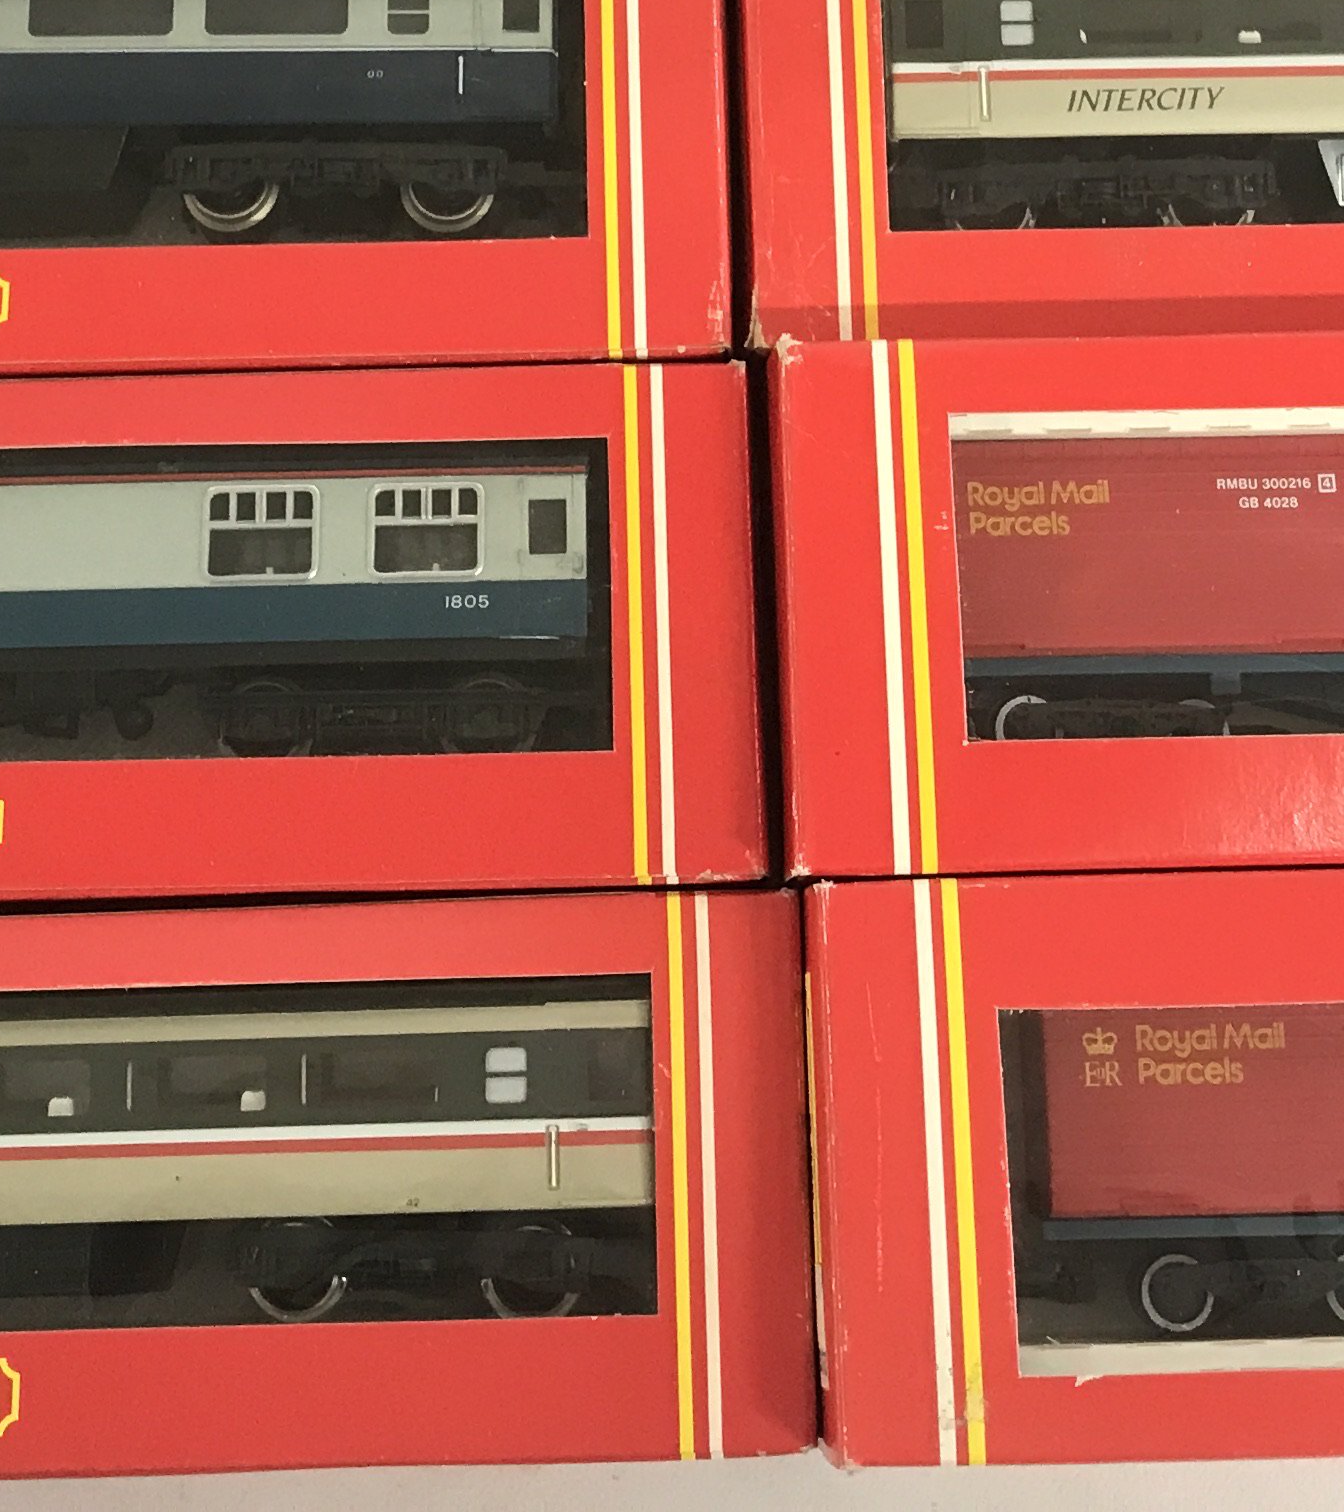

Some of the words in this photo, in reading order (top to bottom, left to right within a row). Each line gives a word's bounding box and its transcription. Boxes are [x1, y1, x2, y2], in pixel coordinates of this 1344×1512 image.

[1067, 86, 1225, 112] INTERCITY
[967, 481, 1045, 512] Royal
[1050, 479, 1110, 505] Mail
[1216, 478, 1258, 490] RMBU
[1262, 477, 1312, 490] 300216
[1238, 496, 1259, 509] GB
[1263, 496, 1299, 509] 4028
[969, 510, 1070, 536] Parcels
[445, 594, 490, 609] 1805
[1135, 1023, 1218, 1058] Royal
[1223, 1022, 1286, 1050] Mail
[1138, 1056, 1244, 1085] Parcels
